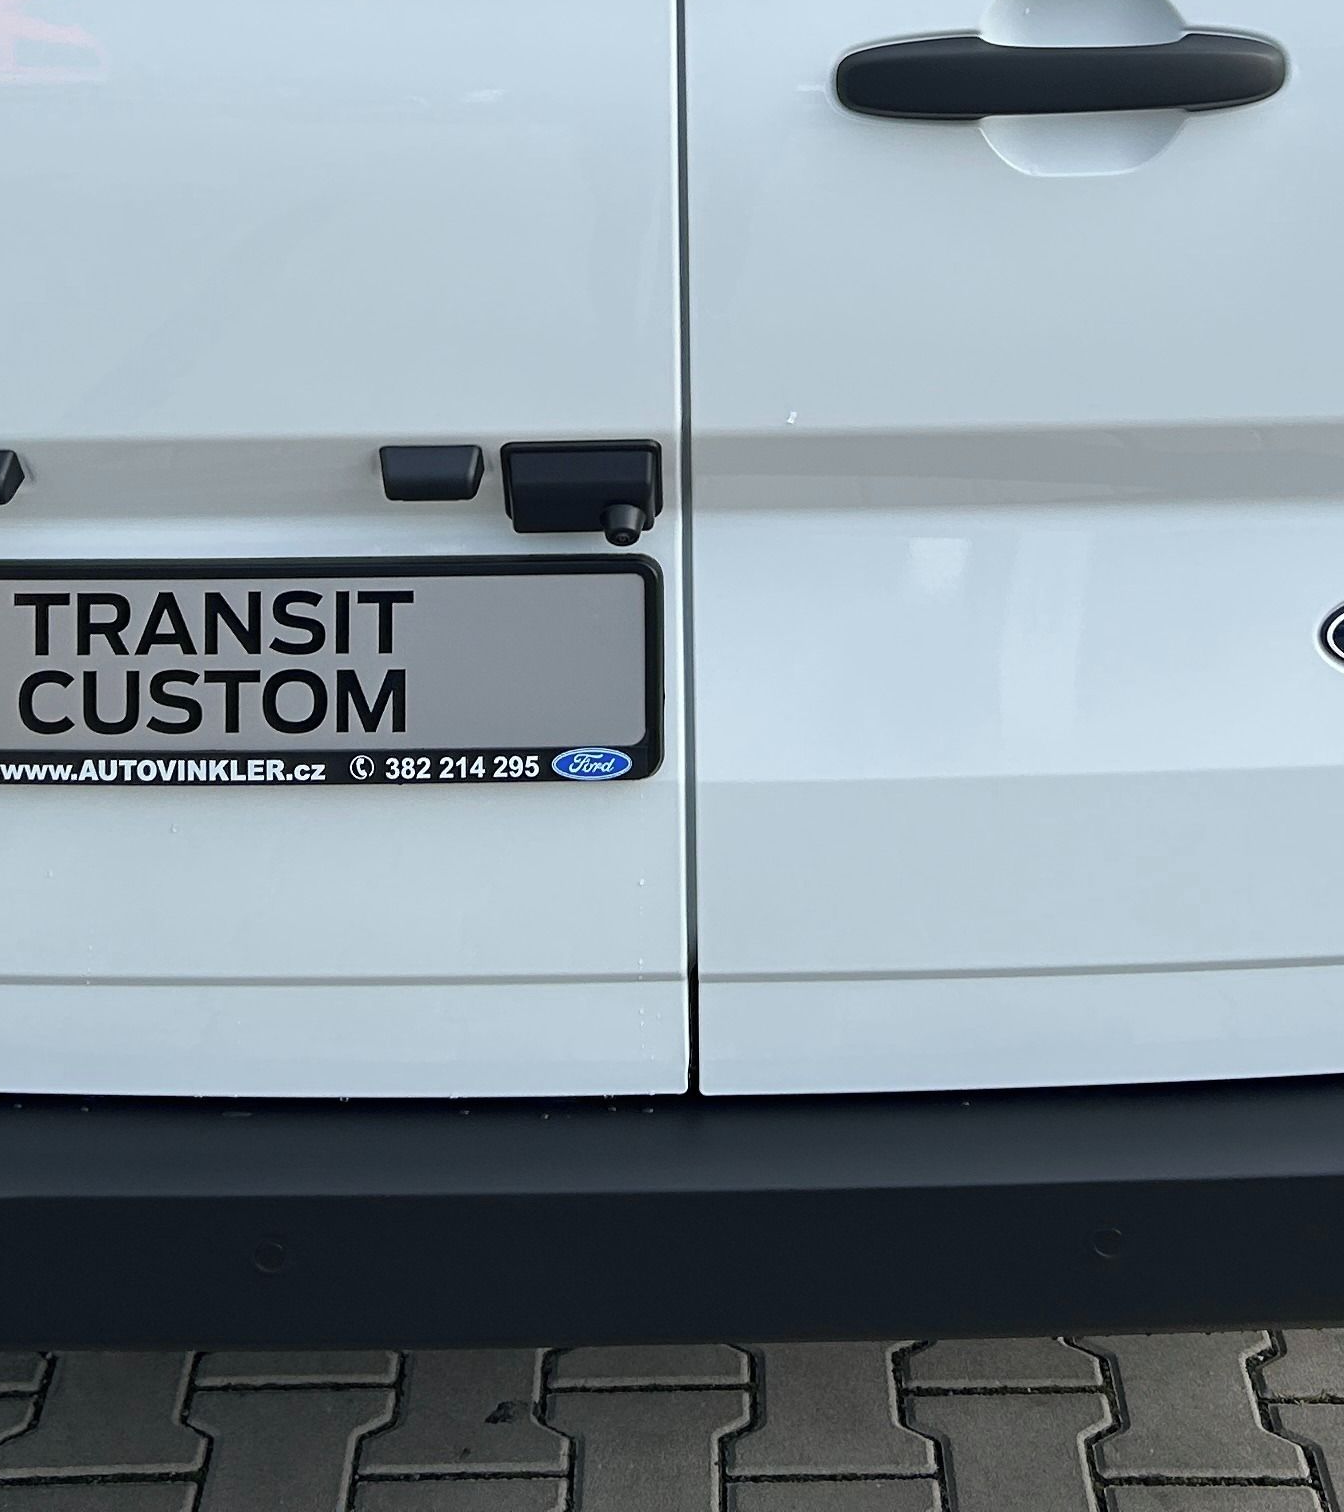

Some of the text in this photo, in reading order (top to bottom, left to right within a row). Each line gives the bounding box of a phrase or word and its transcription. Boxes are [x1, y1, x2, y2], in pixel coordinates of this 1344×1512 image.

[14, 590, 415, 656] TRANSIT
[19, 669, 406, 735] CUSTOM
[0, 759, 326, 782] www.AUTOVINKLER.cz
[386, 757, 430, 779] 382
[439, 756, 485, 778] 214
[493, 756, 540, 778] 295
[569, 753, 615, 773] Ford
